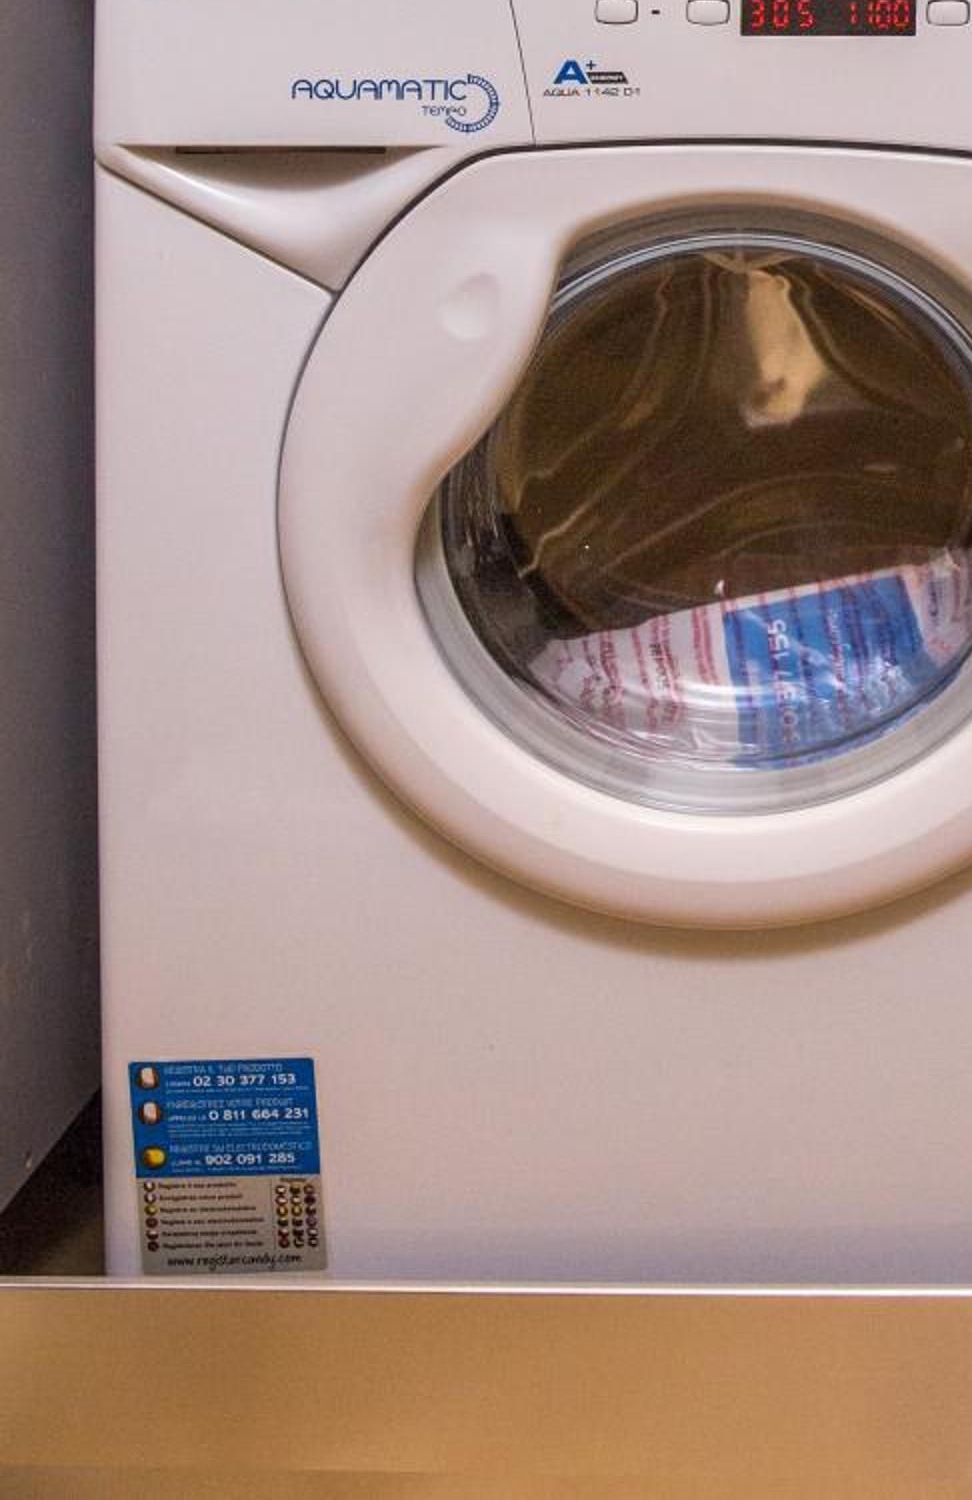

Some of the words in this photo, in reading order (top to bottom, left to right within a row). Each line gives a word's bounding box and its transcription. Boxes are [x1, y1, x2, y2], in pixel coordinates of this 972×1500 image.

[292, 79, 467, 101] AQUAMATIC
[421, 105, 467, 117] TEMPO
[193, 1075, 211, 1087] 02
[217, 1074, 235, 1087] 30
[240, 1074, 265, 1085] 377
[271, 1073, 296, 1085] 153
[208, 1111, 219, 1121] 0
[223, 1110, 245, 1121] 811
[284, 1108, 309, 1119] 231
[236, 1153, 262, 1164] 091
[268, 1152, 295, 1163] 285
